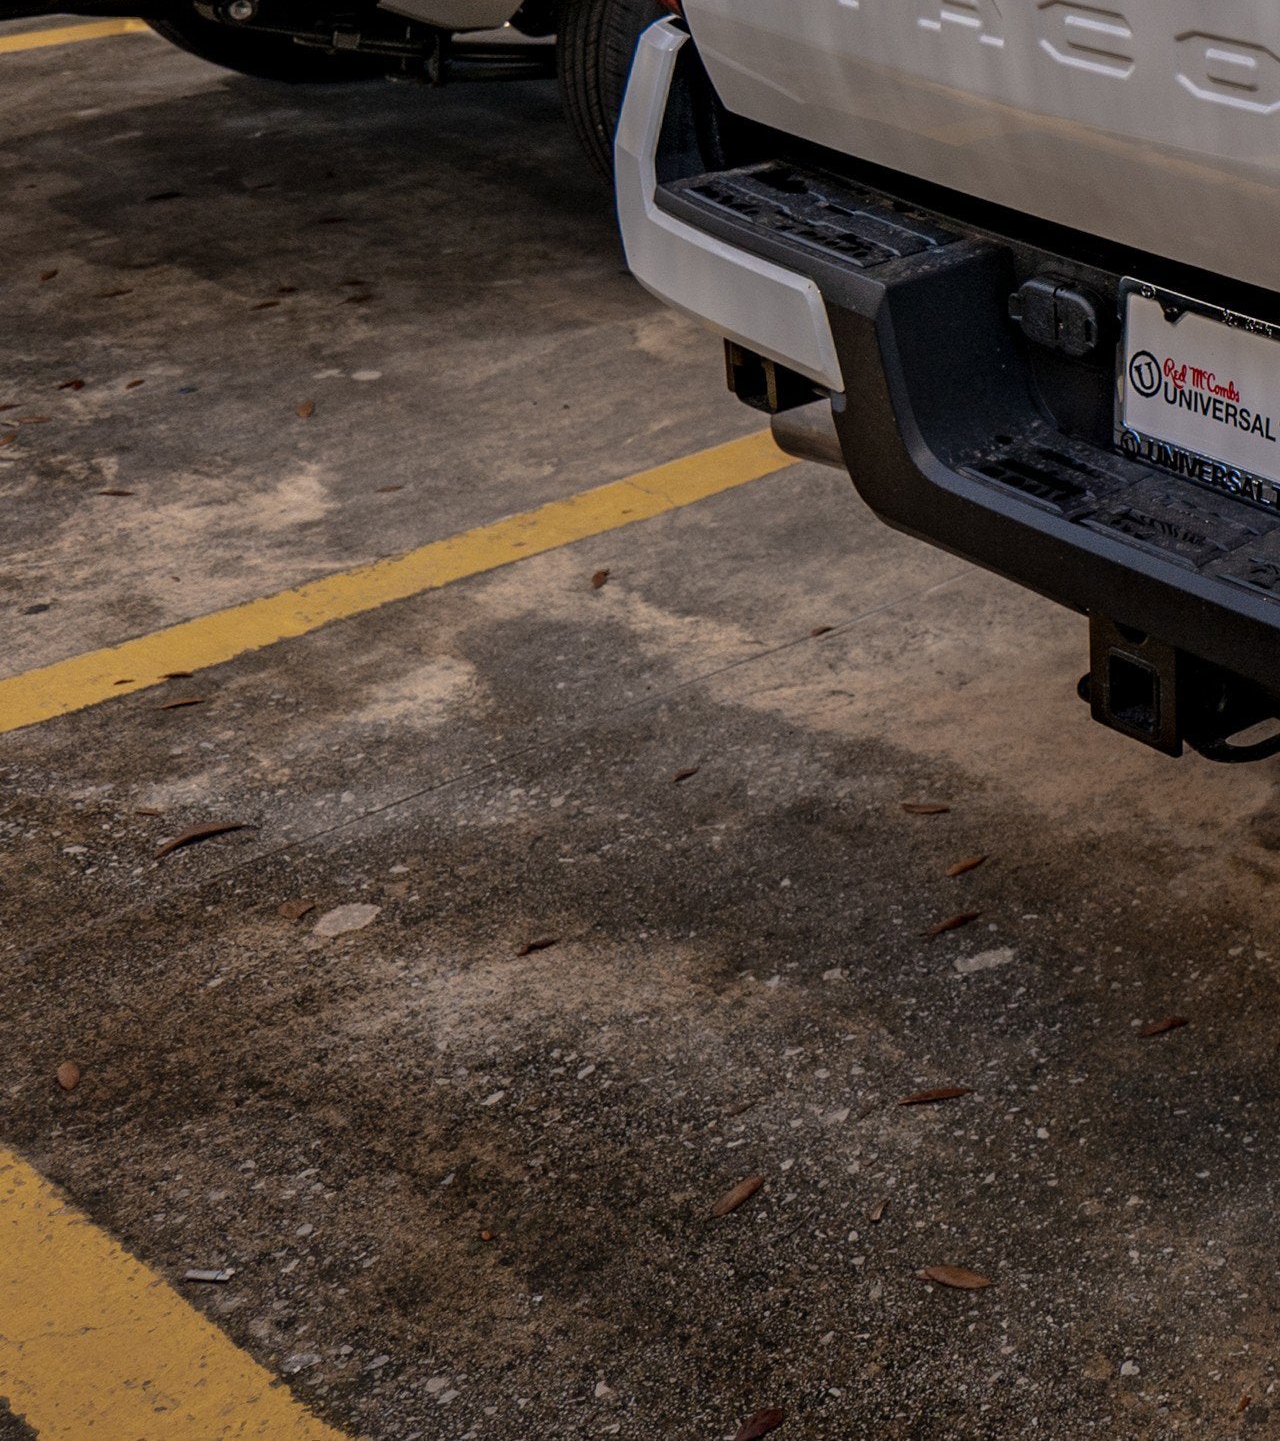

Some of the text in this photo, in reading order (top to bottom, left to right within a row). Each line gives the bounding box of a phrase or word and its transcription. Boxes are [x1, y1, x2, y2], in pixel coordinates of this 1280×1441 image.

[1164, 358, 1240, 403] Red McCombs
[1163, 381, 1276, 442] UNIVERSAL
[1147, 439, 1271, 504] UNIVERSAL
